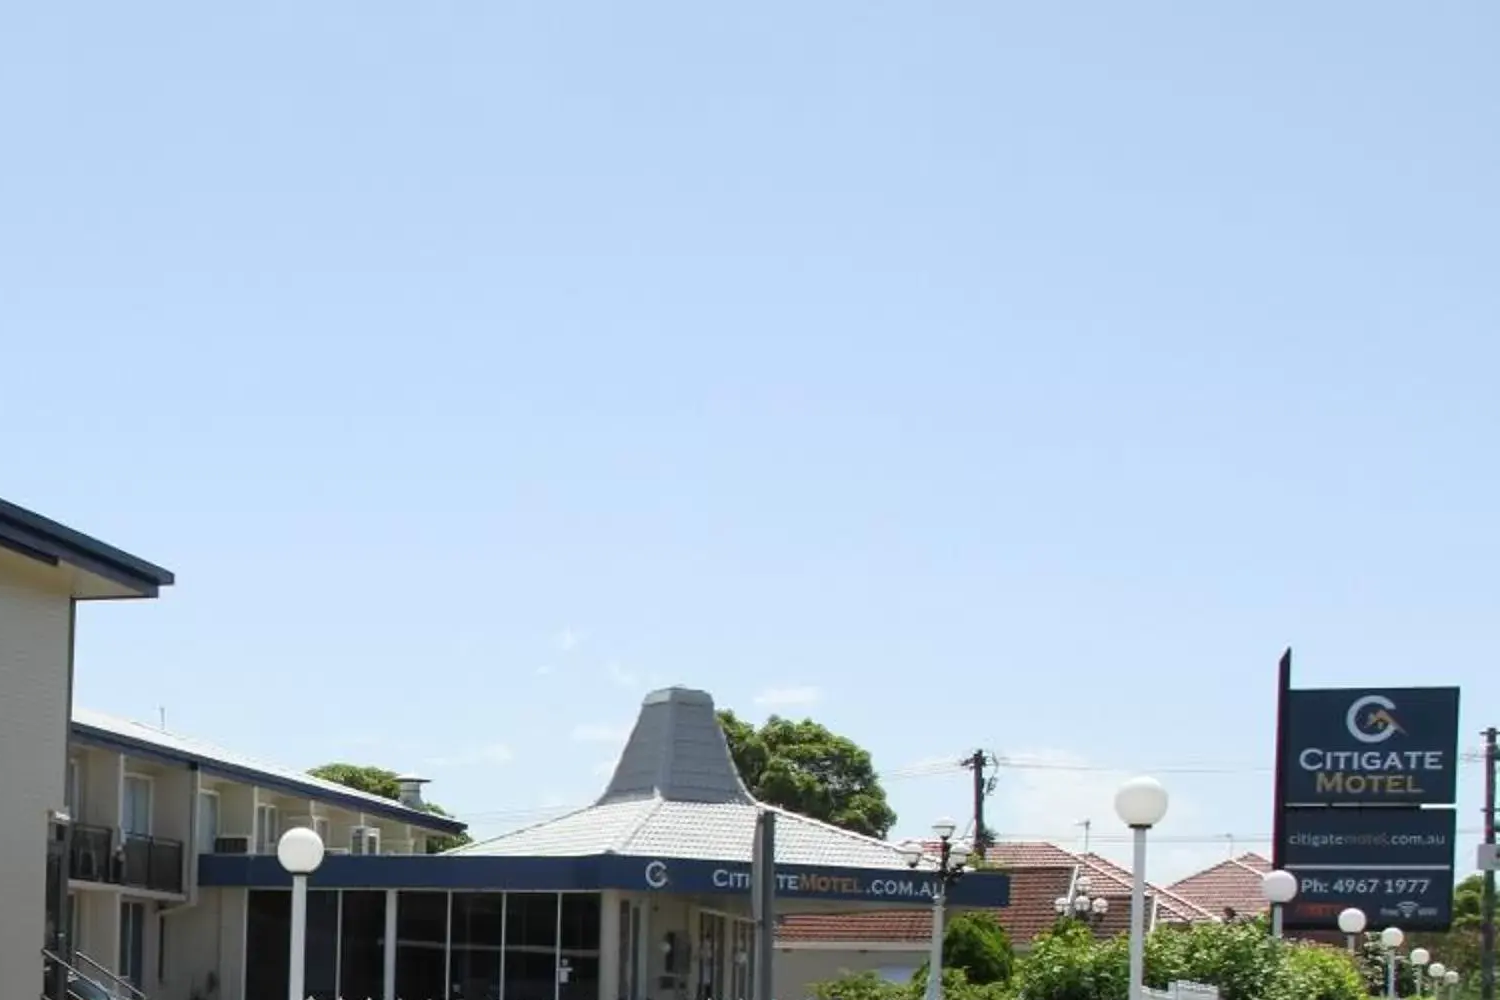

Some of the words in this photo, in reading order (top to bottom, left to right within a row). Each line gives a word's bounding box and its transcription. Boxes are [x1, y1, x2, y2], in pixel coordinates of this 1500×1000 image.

[1299, 748, 1443, 770] CITIGATE
[1315, 771, 1426, 793] MOTEL
[712, 869, 946, 896] CITITEMOTEL.COM.AU
[1301, 878, 1329, 893] Ph:
[1333, 878, 1379, 893] 4967
[1384, 878, 1430, 893] 1977
